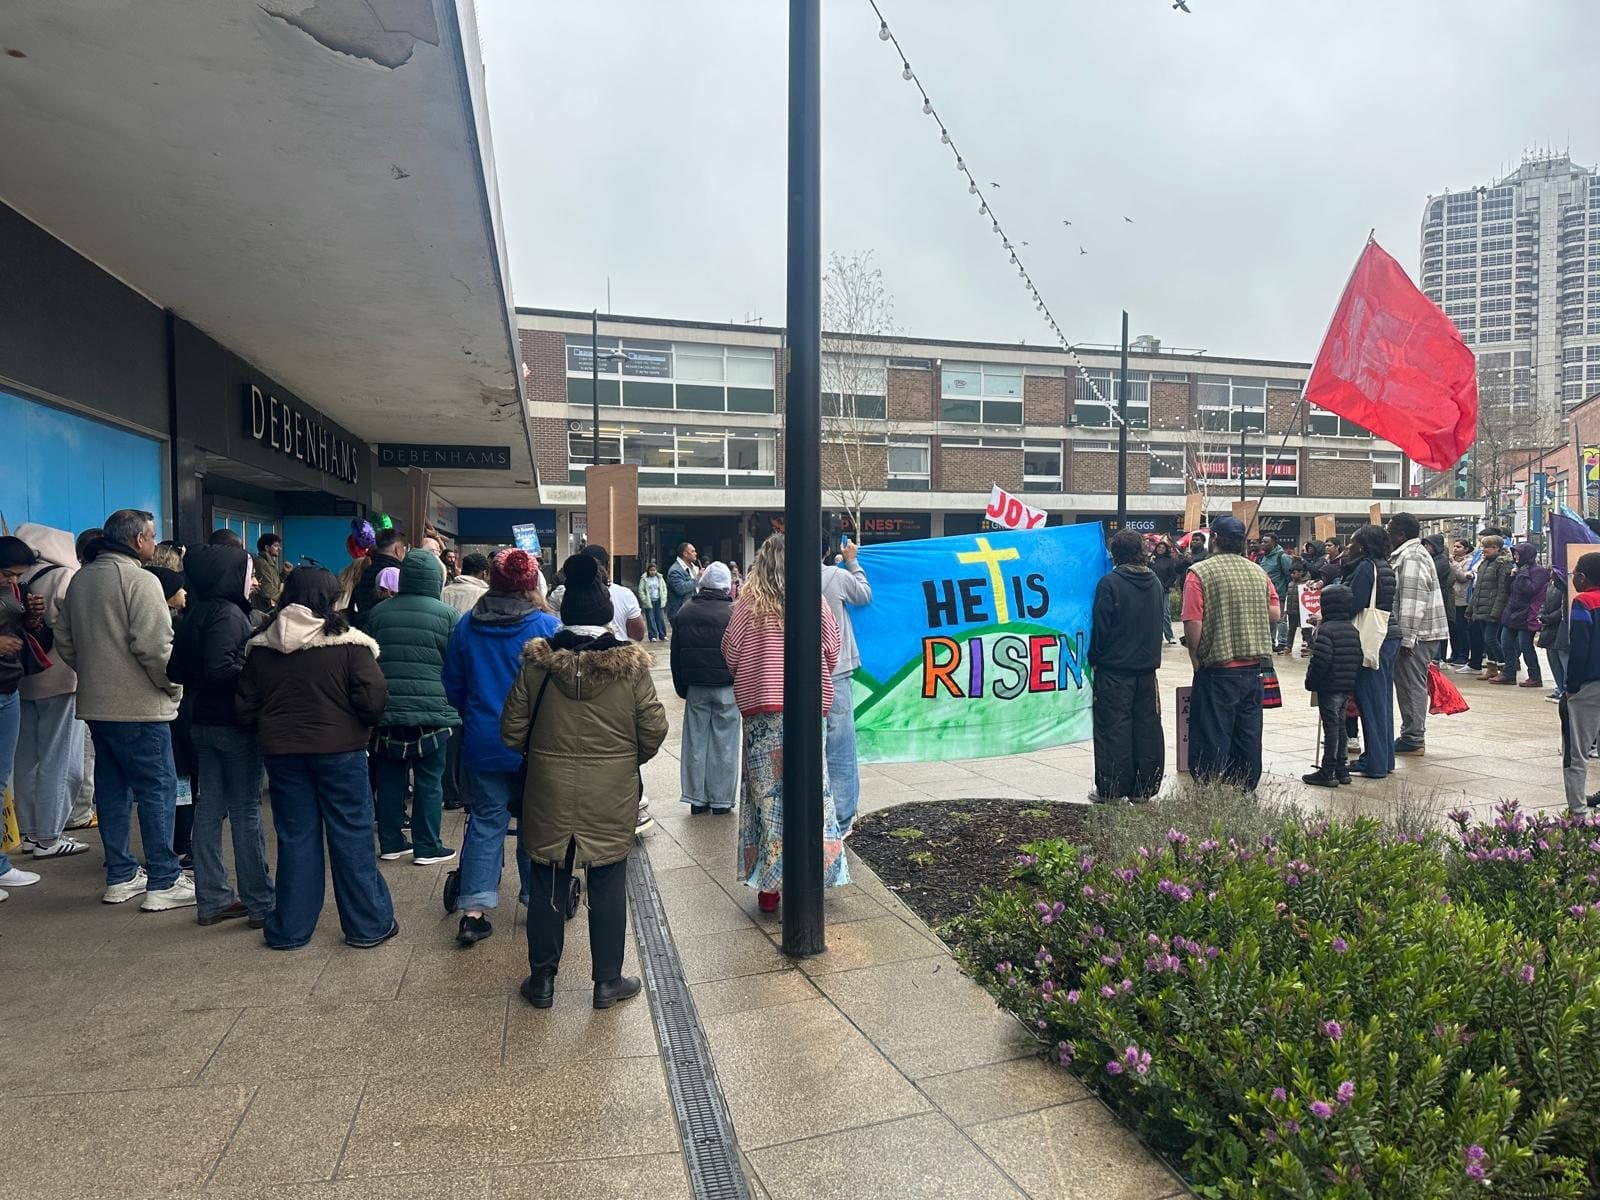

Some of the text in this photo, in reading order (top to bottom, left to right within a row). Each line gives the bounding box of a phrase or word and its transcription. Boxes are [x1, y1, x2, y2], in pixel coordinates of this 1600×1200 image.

[251, 384, 359, 485] DEBENHAMS
[383, 449, 506, 464] DEBENHAMS
[864, 519, 903, 531] NEST
[987, 491, 1045, 529] JOY
[1125, 521, 1155, 530] REGGS
[922, 574, 1050, 628] HE IS
[921, 631, 1084, 700] RISEN
